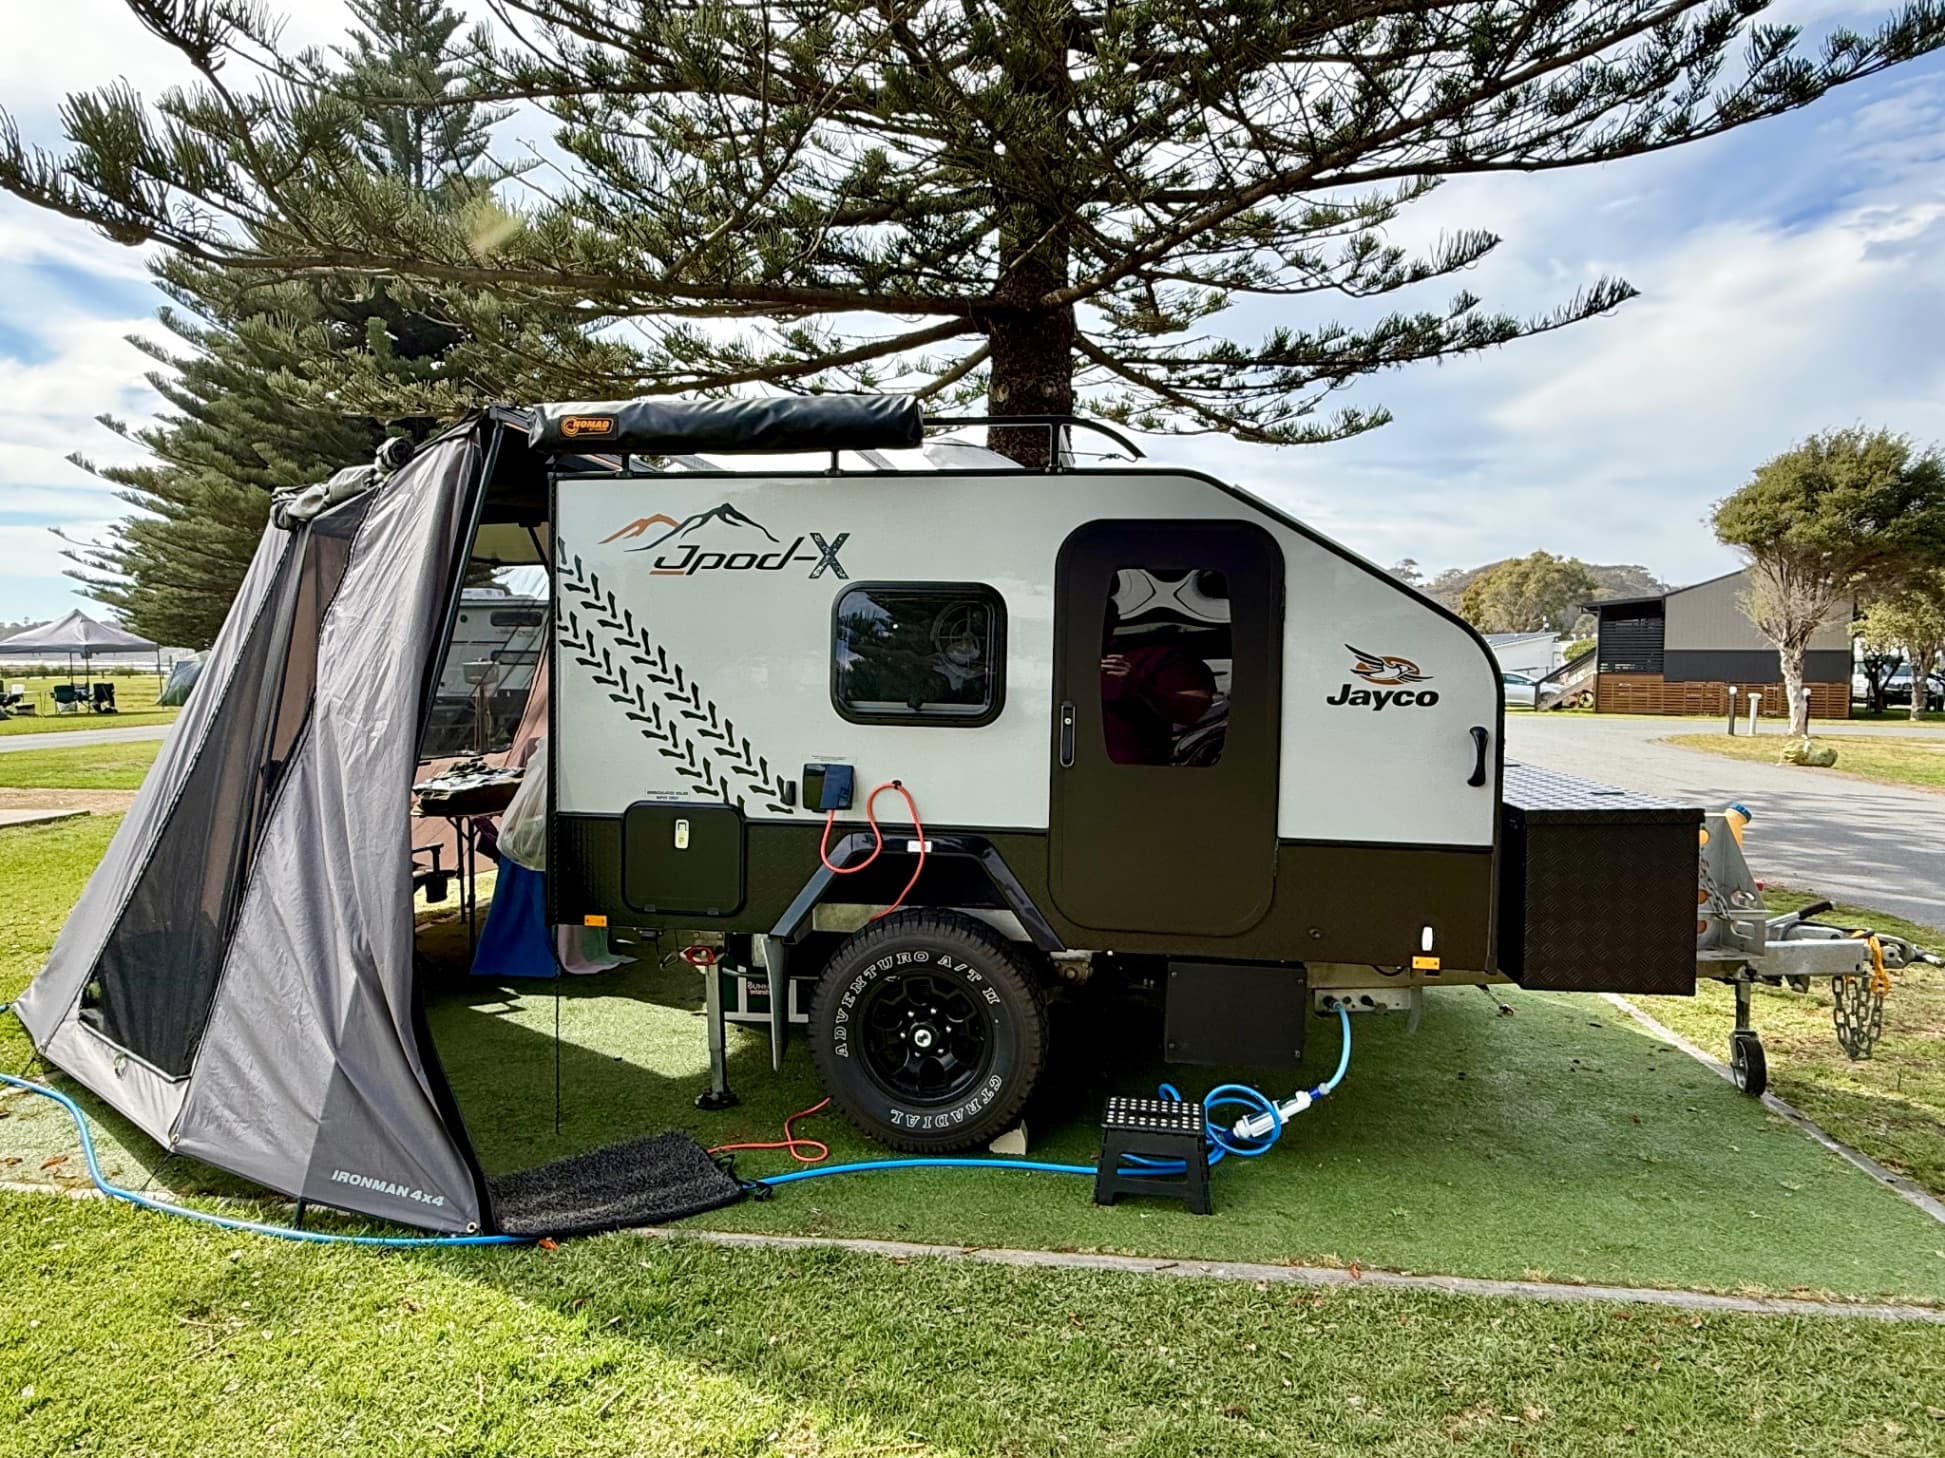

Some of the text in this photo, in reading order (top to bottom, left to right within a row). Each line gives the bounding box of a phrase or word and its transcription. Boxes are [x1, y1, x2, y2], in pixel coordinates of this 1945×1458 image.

[573, 420, 610, 429] NOMAD
[653, 532, 850, 580] Jpod-X
[1326, 683, 1440, 711] Jayco
[834, 951, 930, 1058] ADVENTURO
[937, 954, 982, 983] A/T
[331, 1169, 445, 1207] IRONMAN 4x4
